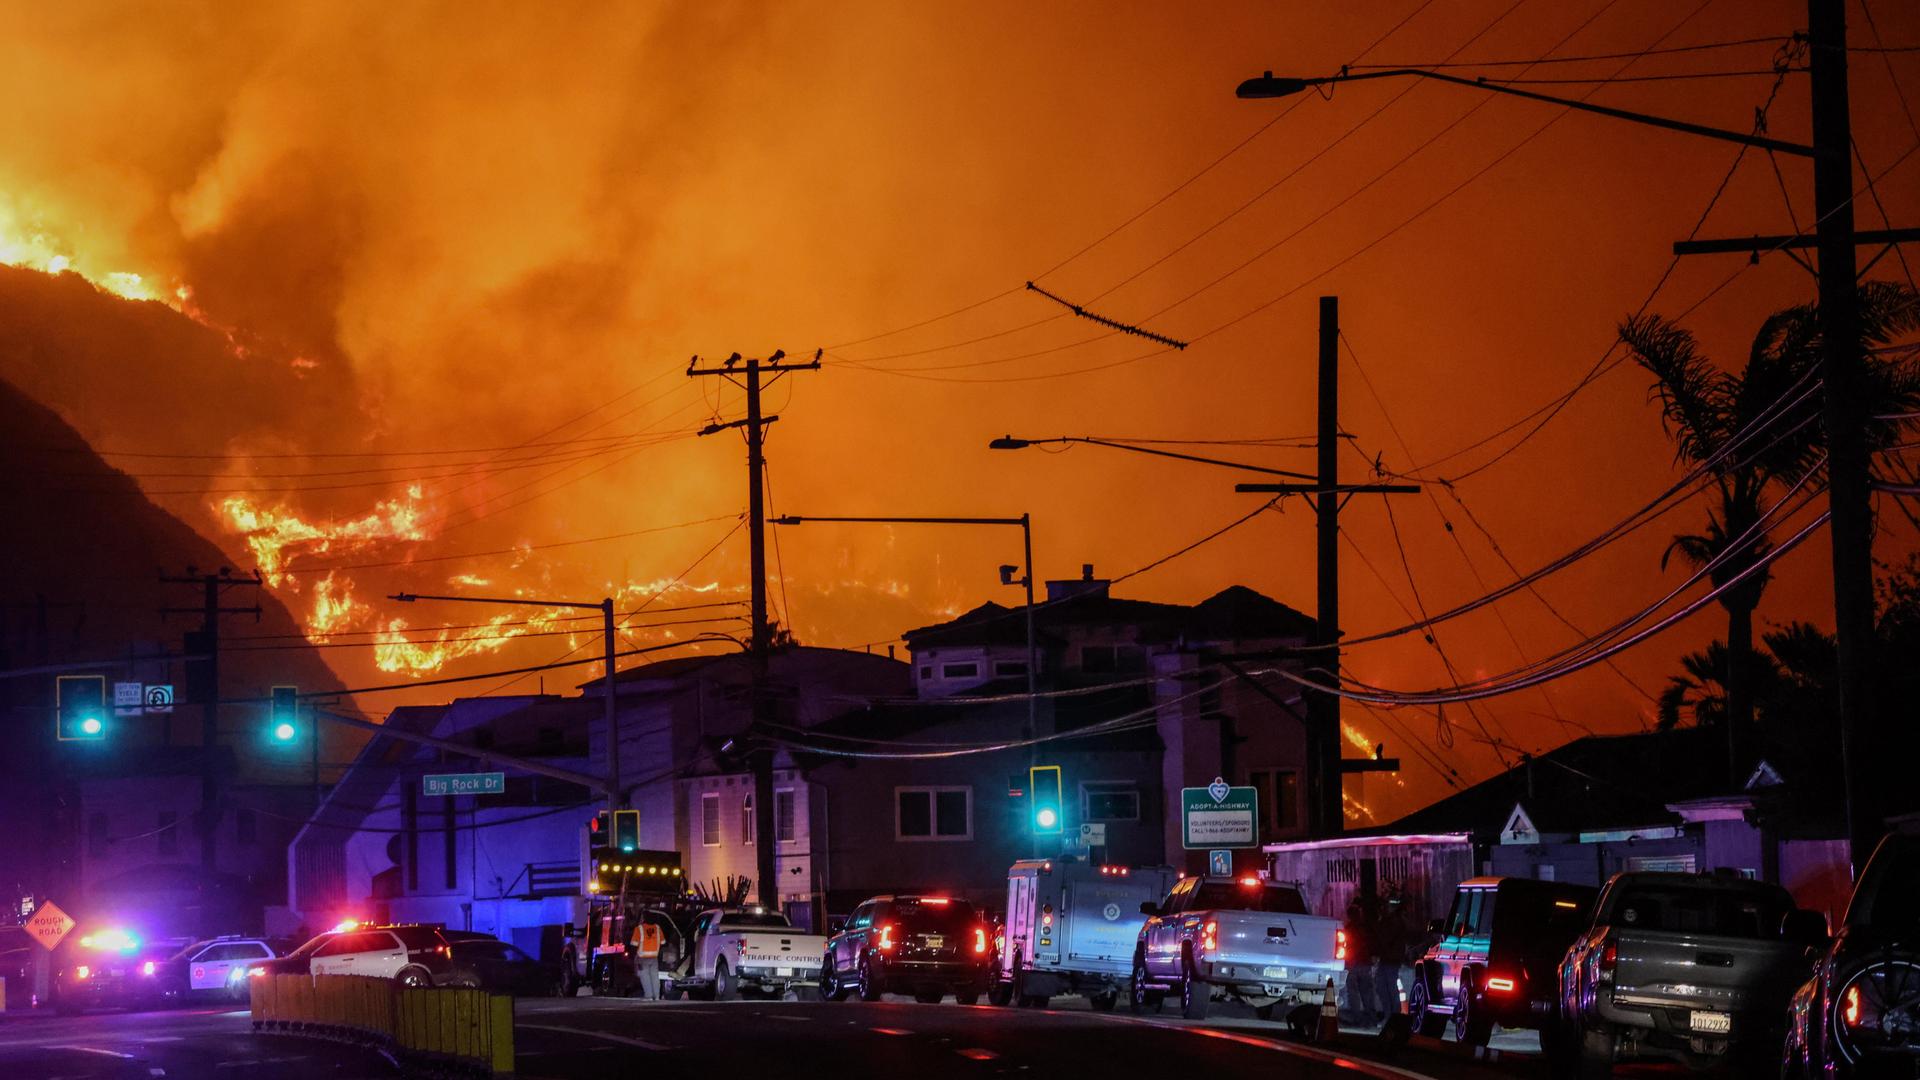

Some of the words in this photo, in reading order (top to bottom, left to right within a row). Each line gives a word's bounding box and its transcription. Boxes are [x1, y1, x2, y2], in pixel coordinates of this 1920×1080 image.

[429, 780, 447, 792] Big
[452, 779, 479, 789] Rock
[485, 778, 498, 788] Dr
[34, 917, 64, 925] ROUGH
[39, 928, 63, 936] ROAD
